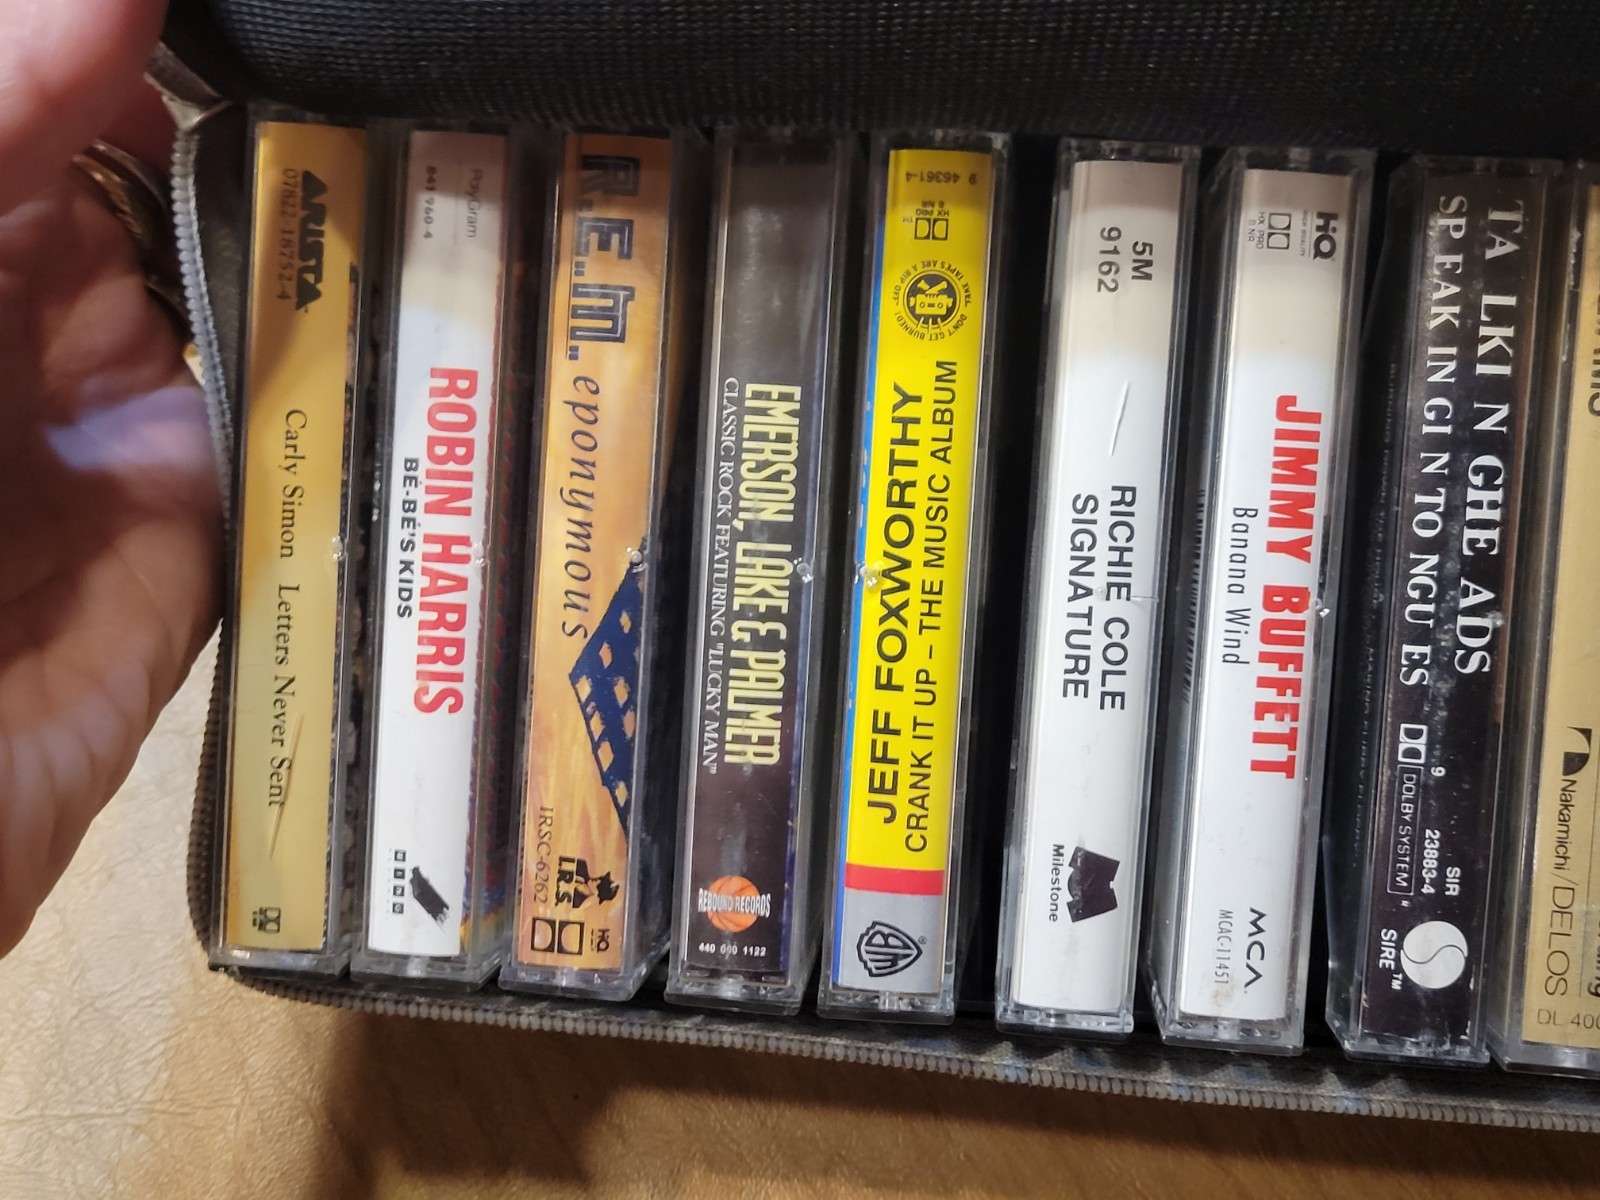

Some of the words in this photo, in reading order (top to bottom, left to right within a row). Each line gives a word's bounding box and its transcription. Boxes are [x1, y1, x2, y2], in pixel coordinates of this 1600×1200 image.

[905, 170, 960, 184] 46361-4
[296, 170, 327, 311] ARISTA
[940, 261, 965, 279] TAPES
[1096, 226, 1123, 293] 9162
[1131, 240, 1154, 282] 5M
[928, 329, 945, 341] GET
[279, 408, 308, 476] Carly
[424, 367, 478, 517] ROBIN
[719, 377, 739, 456] CLASSIC
[930, 360, 958, 464] ALBUM
[716, 460, 734, 518] ROCK
[732, 383, 802, 532] EMERSON,
[1265, 393, 1323, 564] JIMMY
[280, 484, 304, 559] Simon
[400, 457, 422, 553] BÉ-BÉ'S
[560, 375, 600, 640] eponymous
[874, 381, 923, 693] FOXWORTHY
[922, 473, 951, 569] MUSIC
[1105, 484, 1137, 602] RICHIE
[709, 523, 731, 638] FEATURING
[732, 541, 794, 614] LAKE
[1226, 506, 1259, 596] Banana
[275, 583, 300, 666] Letters
[397, 560, 415, 619] KIDS
[413, 533, 473, 714] HARRIS
[918, 579, 944, 635] THE
[1062, 492, 1100, 699] SIGNATURE
[1099, 616, 1131, 711] COLE
[1221, 607, 1252, 665] Wind
[271, 675, 296, 747] Never
[724, 648, 786, 767] PALMER
[914, 668, 937, 706] UP
[1249, 583, 1311, 780] BUFFETT
[912, 715, 935, 740] IT
[269, 755, 293, 808] Sent
[867, 709, 902, 825] JEFF
[904, 750, 933, 853] CRANK
[1400, 772, 1417, 824] DOLBY
[1429, 766, 1446, 778] 9
[534, 806, 554, 905] IRSC-6262
[1048, 843, 1065, 923] Milestone
[1395, 825, 1413, 887] SYSTEM
[1420, 828, 1441, 895] 23883-4
[1444, 865, 1462, 897] SIR
[698, 887, 733, 913] REBOUND
[735, 893, 771, 919] RECORDS
[698, 941, 716, 954] 440
[742, 945, 767, 957] 1122
[1213, 908, 1234, 986] MCAC-11451
[1243, 907, 1268, 989] MCA
[1378, 927, 1398, 970] SIRE
[1536, 1007, 1563, 1027] DL
